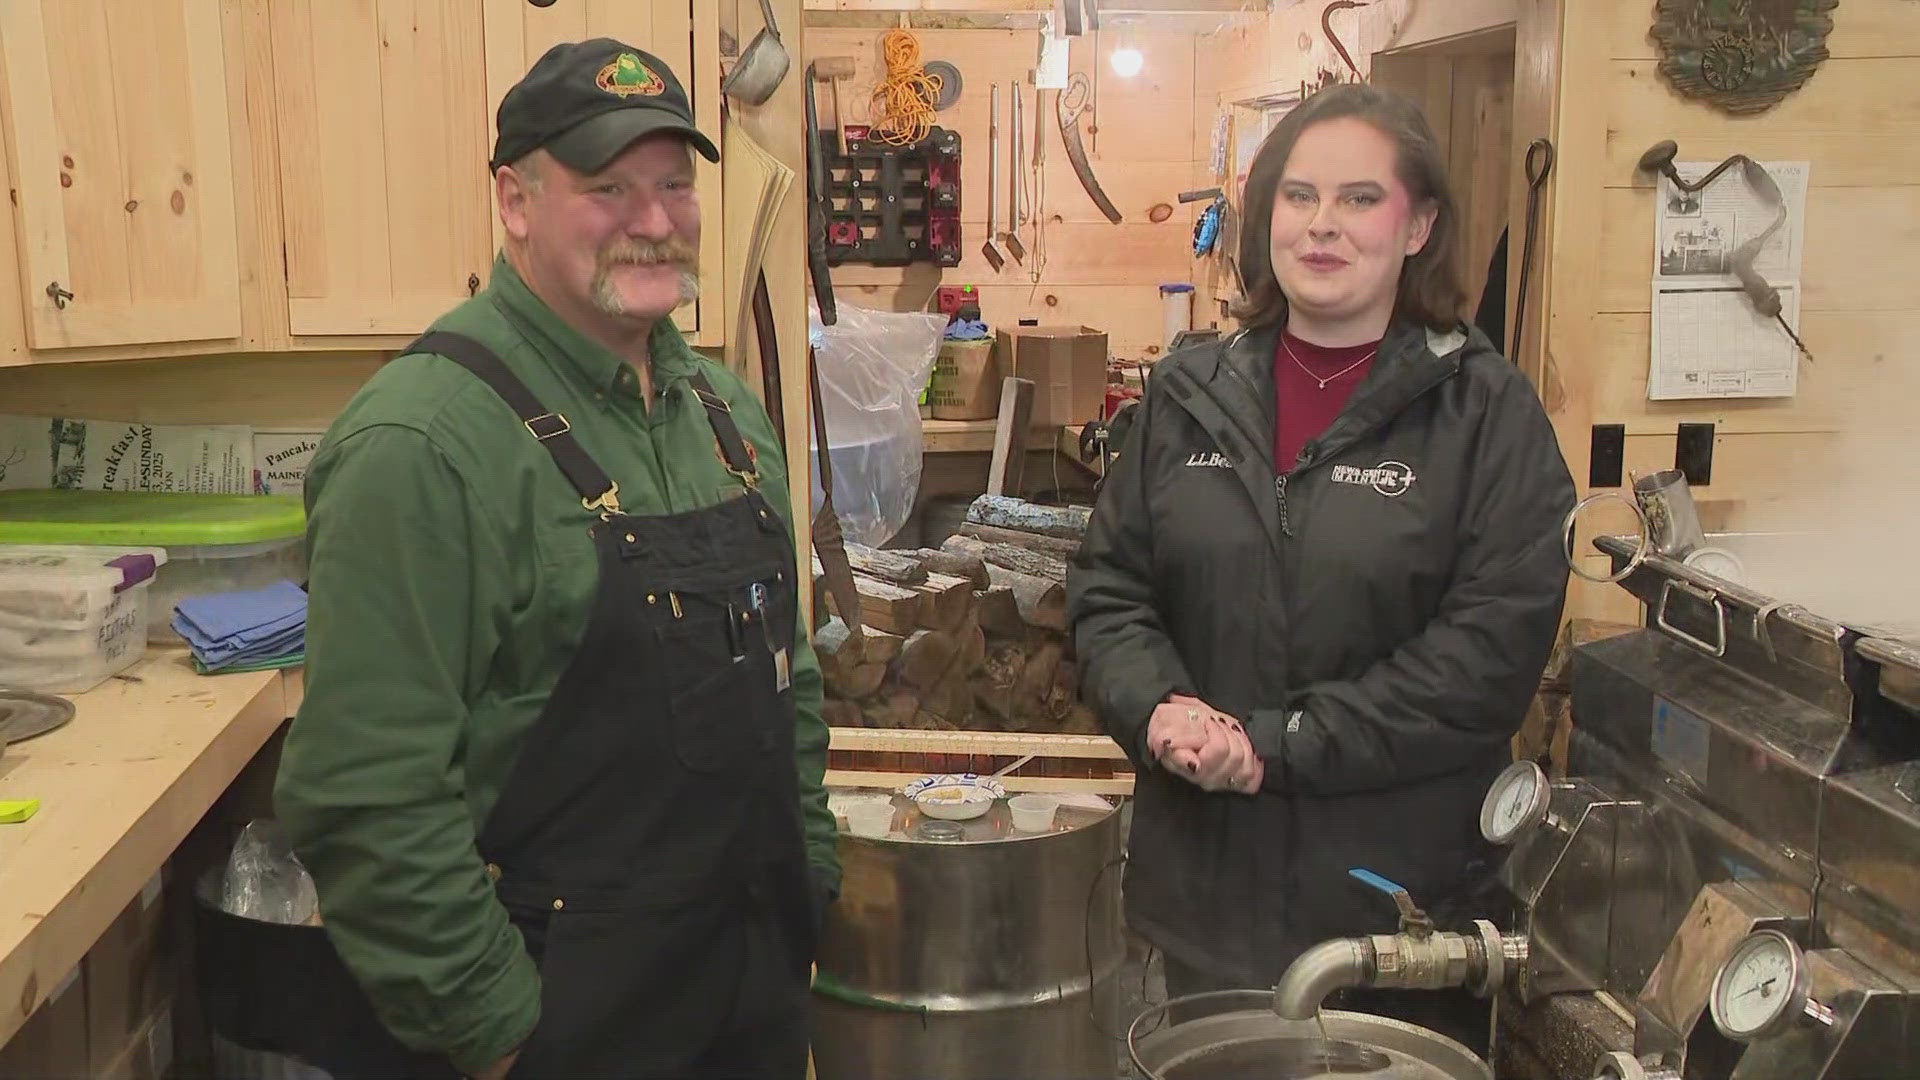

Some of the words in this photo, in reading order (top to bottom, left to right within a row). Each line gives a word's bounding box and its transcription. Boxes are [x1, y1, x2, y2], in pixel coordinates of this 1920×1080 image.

[103, 426, 139, 491] reakfast
[140, 424, 152, 476] SUNDAY
[265, 441, 317, 466] Pancake
[152, 452, 164, 478] 2025
[267, 471, 304, 480] MAINE
[1333, 465, 1361, 476] NEWS
